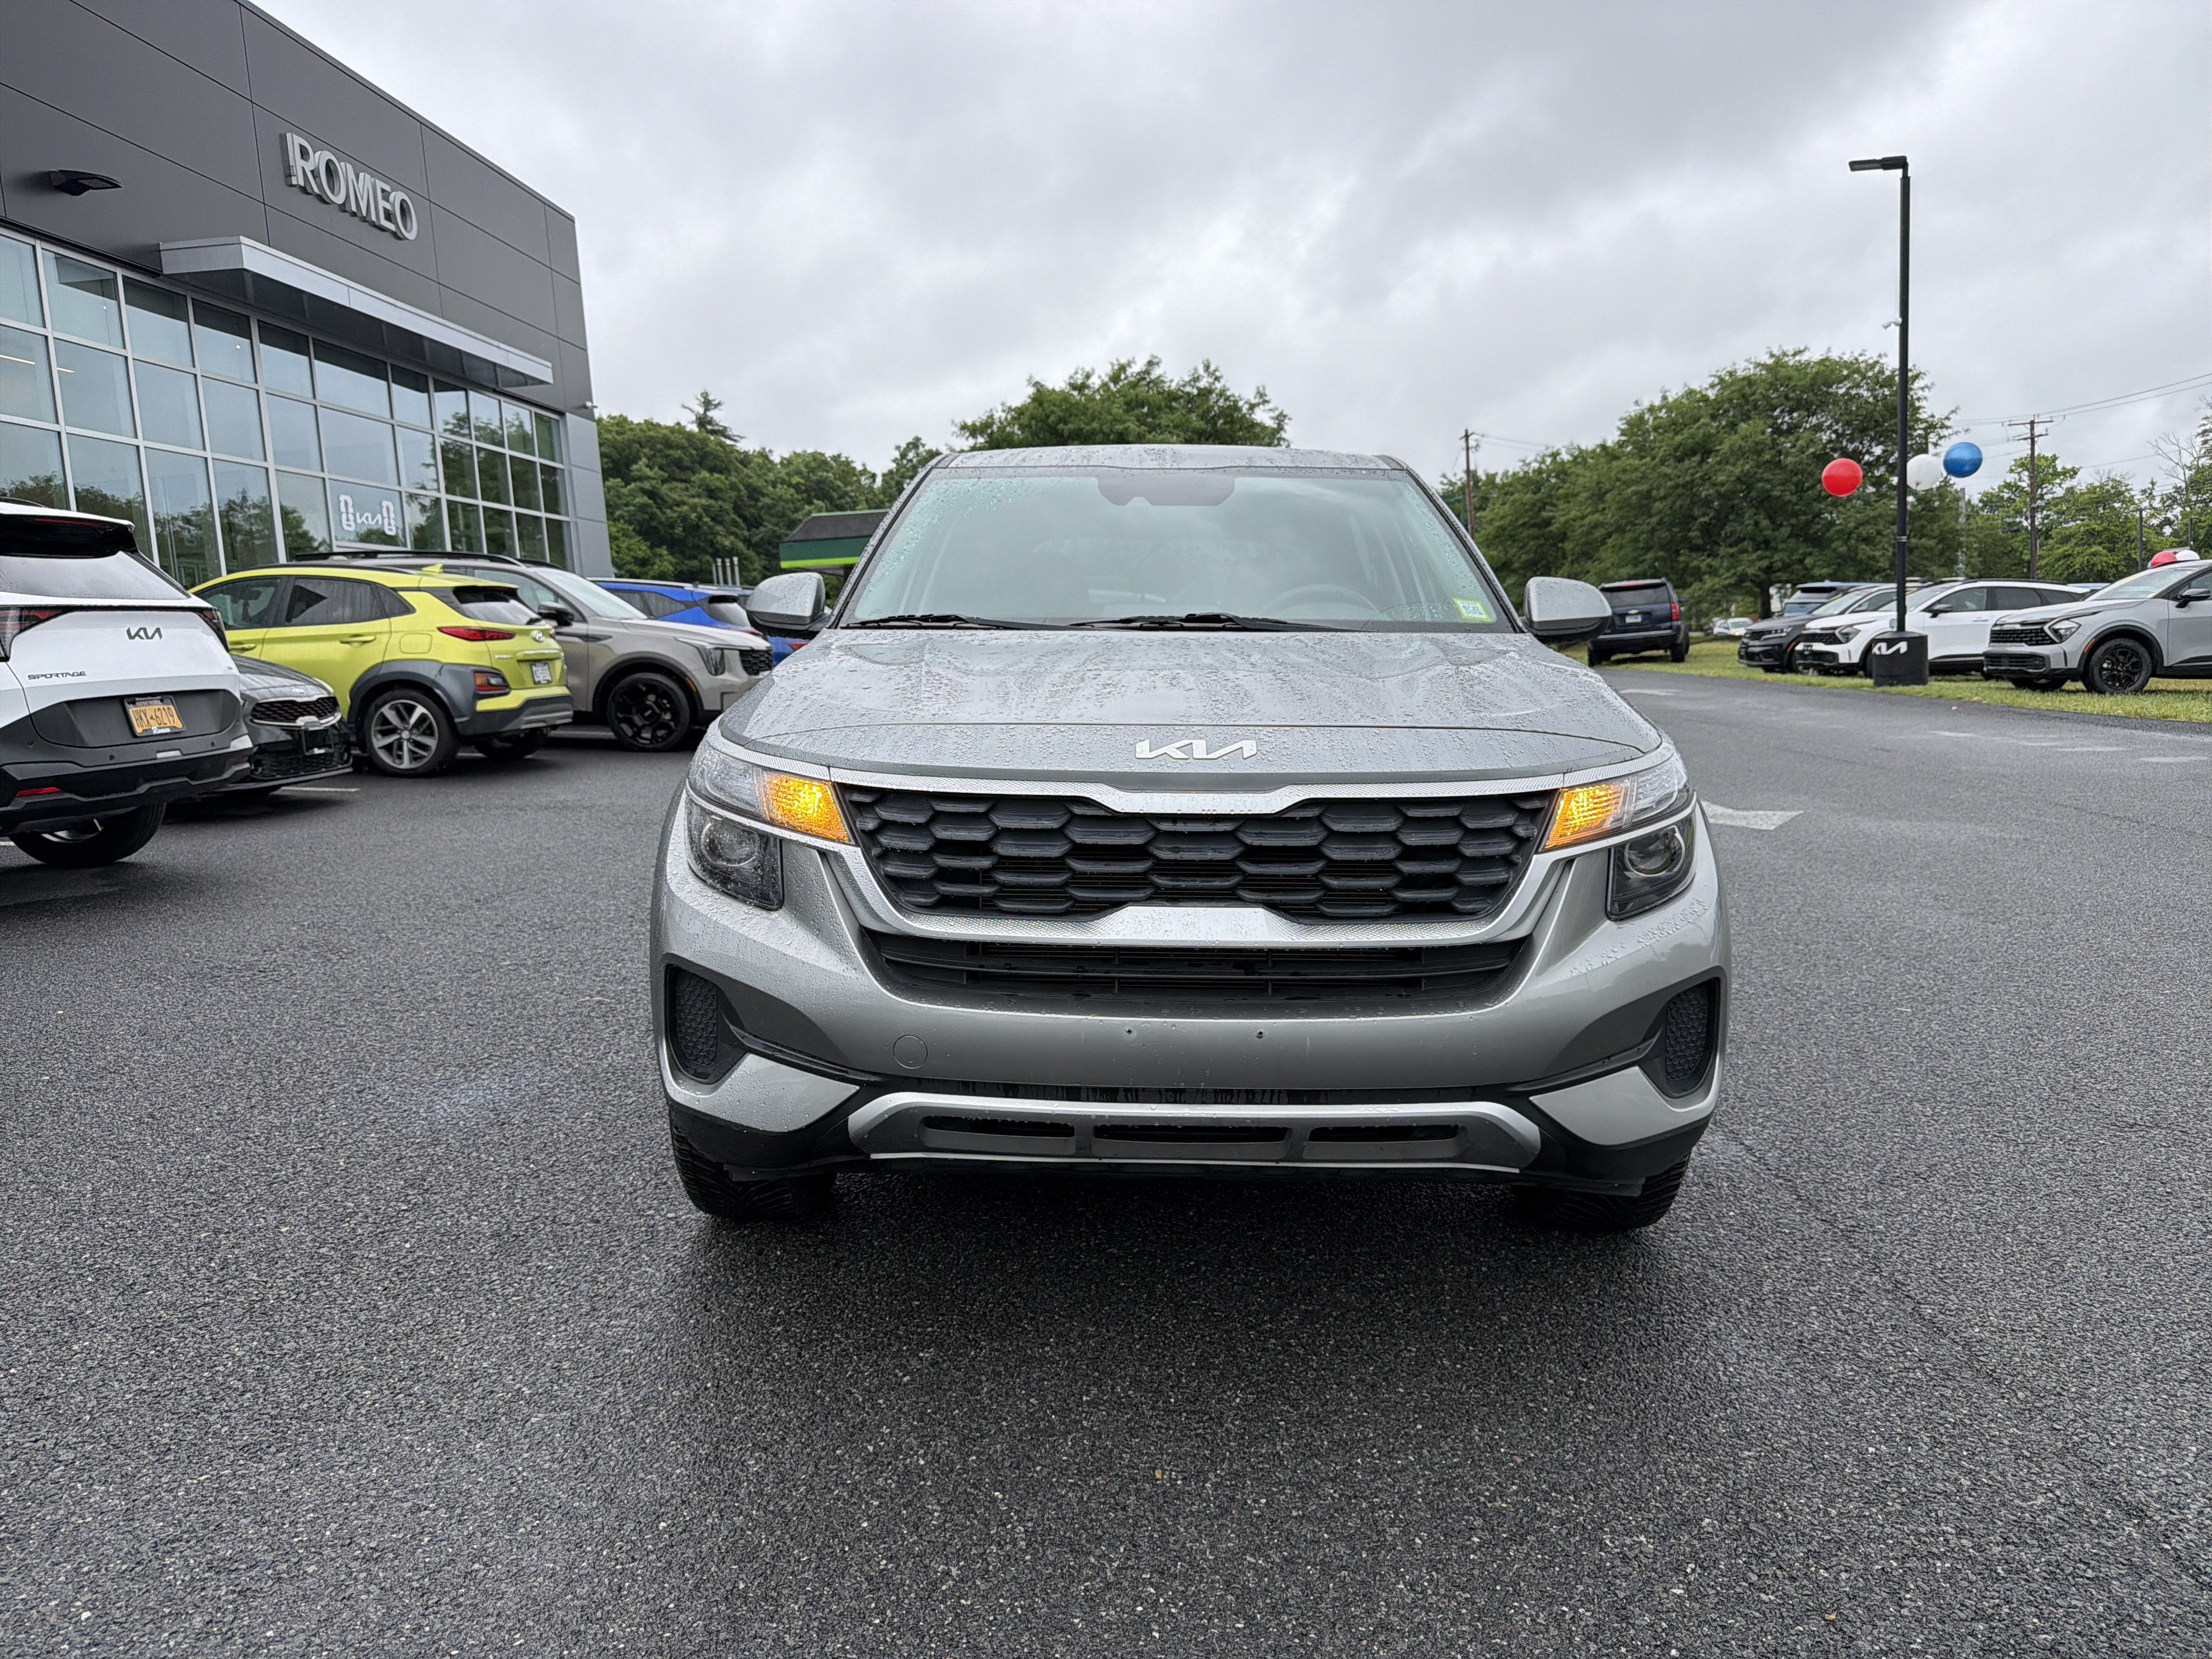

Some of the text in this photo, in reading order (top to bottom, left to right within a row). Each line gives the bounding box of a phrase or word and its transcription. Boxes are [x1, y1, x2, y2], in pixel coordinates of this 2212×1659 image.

[285, 132, 418, 240] ROMEO
[356, 512, 382, 525] KIA
[126, 627, 163, 640] KIA
[27, 670, 87, 680] SPORTAGE
[1135, 739, 1257, 759] KIA
